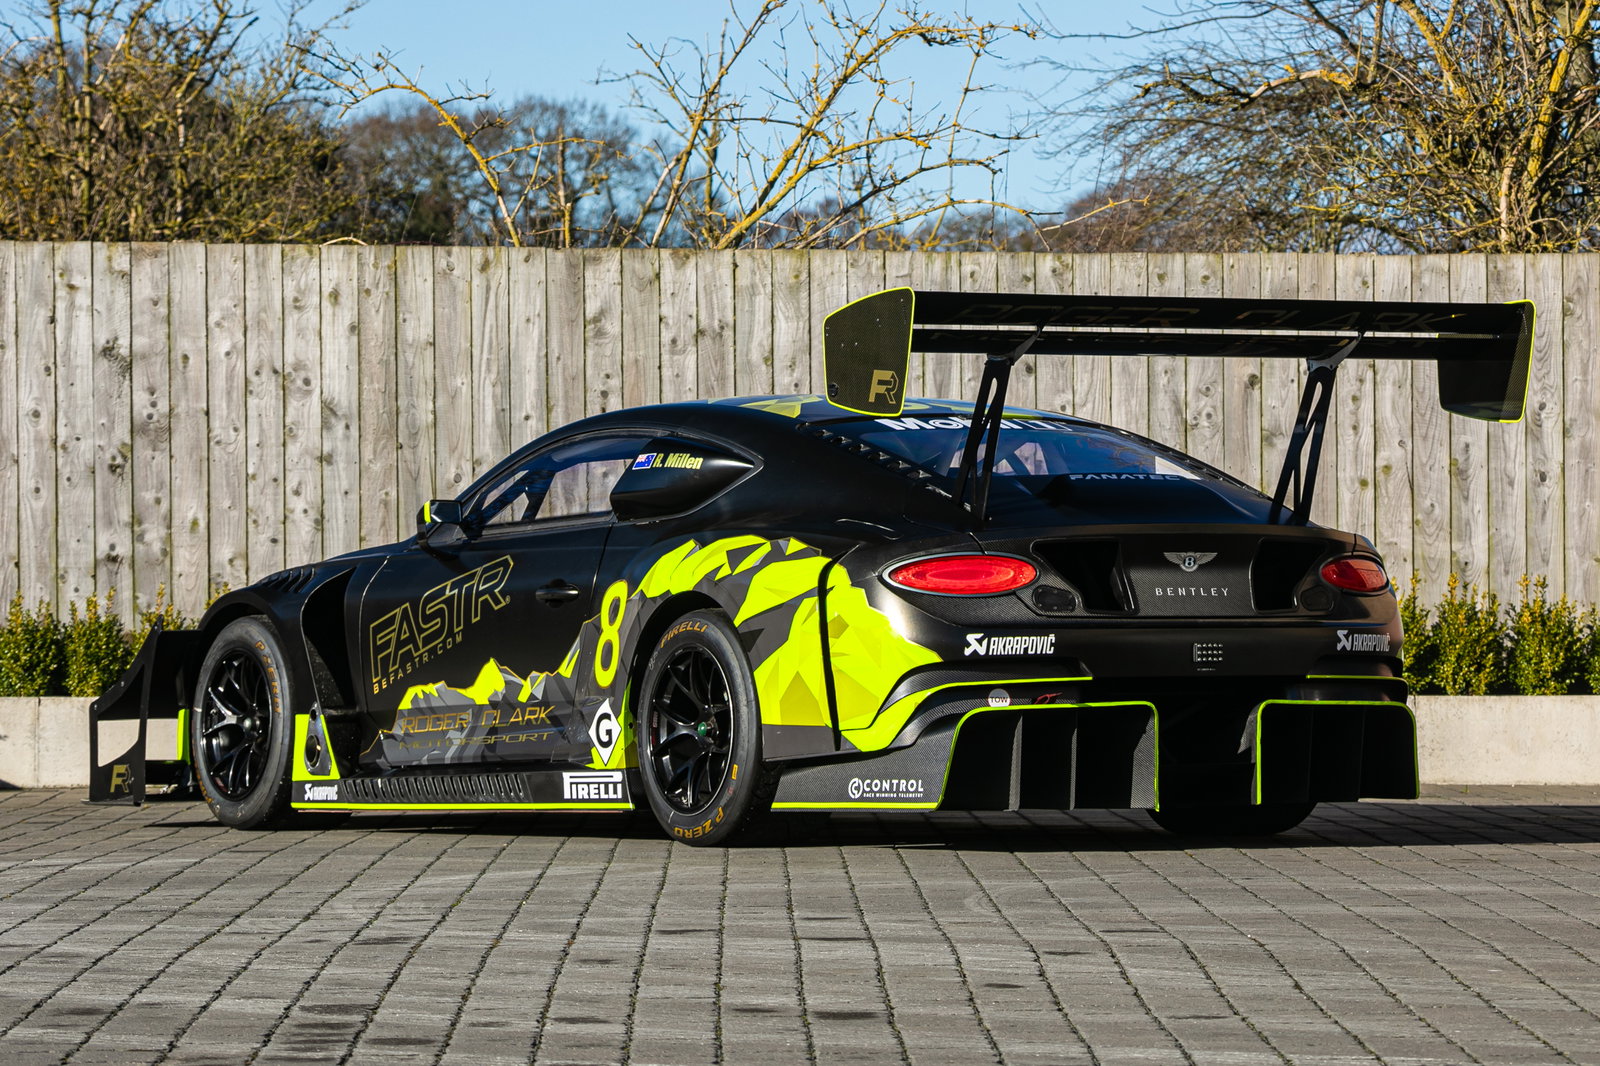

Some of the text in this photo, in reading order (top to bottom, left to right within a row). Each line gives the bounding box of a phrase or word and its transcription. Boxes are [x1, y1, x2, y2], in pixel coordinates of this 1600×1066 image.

[653, 453, 704, 470] R. Millen
[1155, 587, 1228, 596] BENTLEY
[255, 641, 265, 651] P
[594, 579, 628, 689] 8
[660, 621, 708, 649] PIRELLI
[373, 632, 463, 694] BEFASTR.COM
[401, 705, 555, 734] ROGER CLARK
[595, 712, 613, 749] G
[562, 771, 623, 799] PIRELLI
[863, 779, 924, 792] CONTROL
[674, 806, 724, 839] P ZERO
